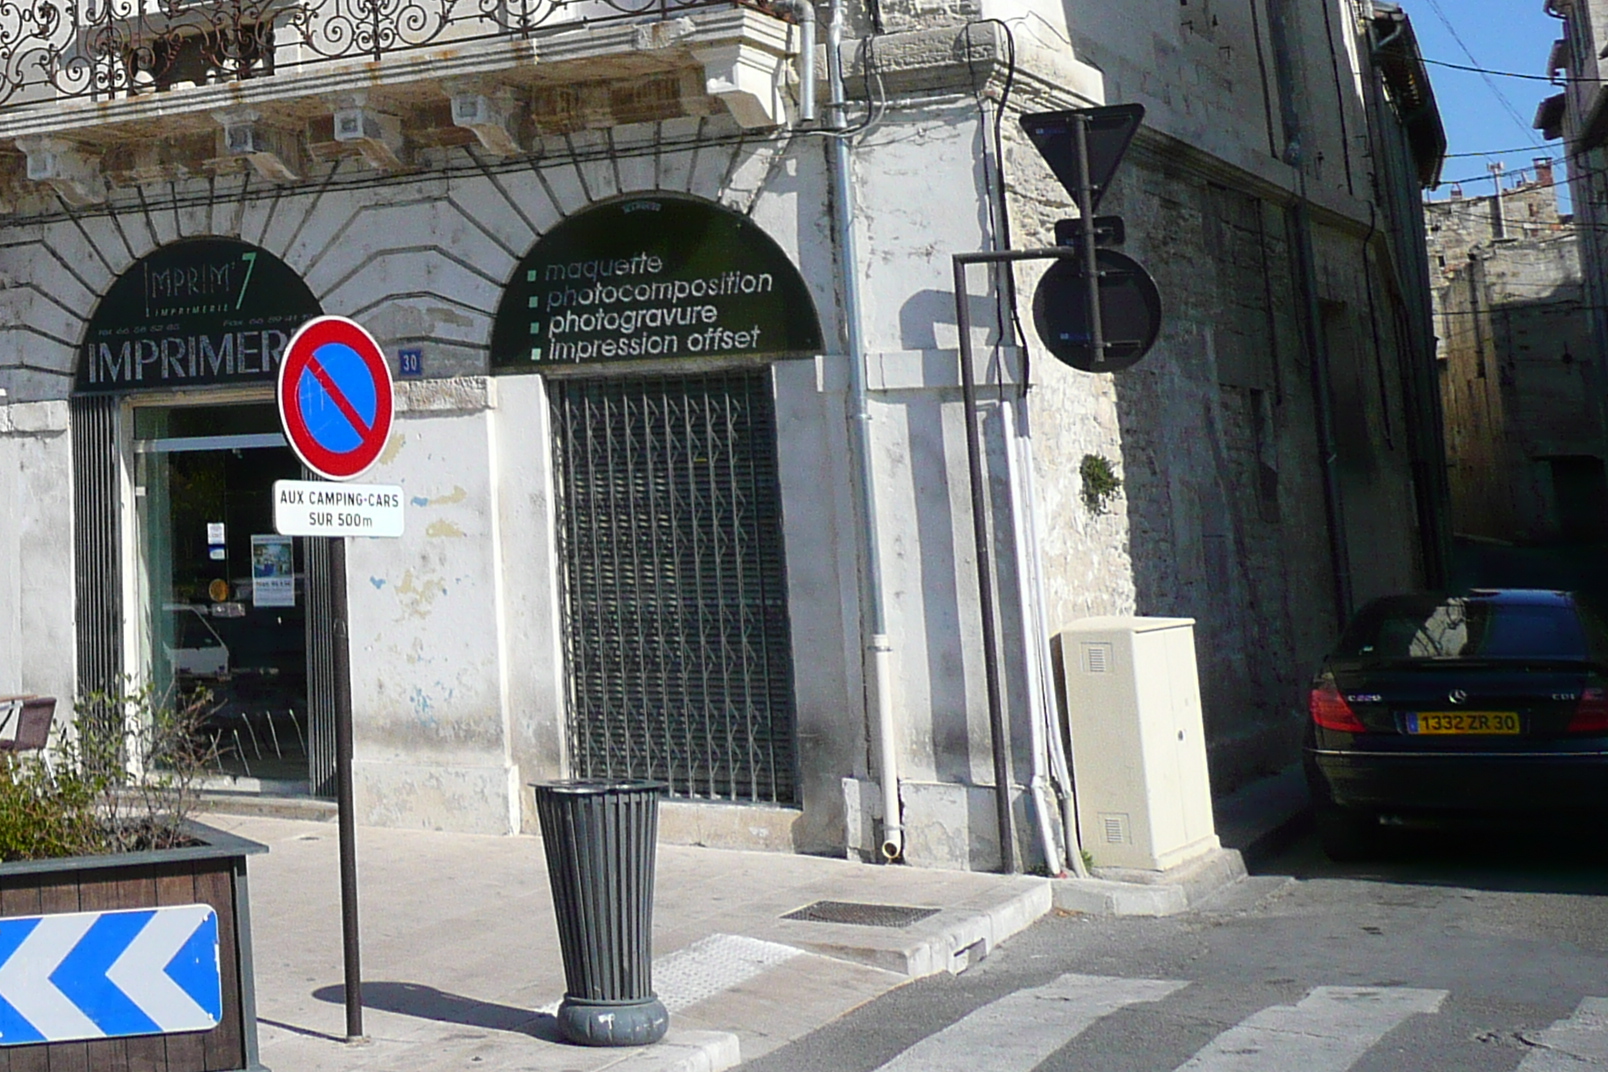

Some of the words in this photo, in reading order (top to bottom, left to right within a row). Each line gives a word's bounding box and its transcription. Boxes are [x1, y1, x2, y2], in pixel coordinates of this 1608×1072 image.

[546, 251, 663, 283] maquette
[547, 271, 774, 312] photocomposition
[548, 304, 719, 340] photogravure
[88, 327, 300, 384] IMPRIMER
[549, 331, 679, 364] impression
[687, 324, 762, 352] offset
[403, 353, 418, 373] 30
[280, 490, 304, 505] AUX
[309, 491, 399, 508] CAMPING-CARS
[309, 512, 333, 526] SUR
[338, 513, 372, 527] 500m
[1422, 715, 1465, 731] 1332
[1467, 714, 1490, 730] ZR
[1494, 714, 1516, 730] 30
